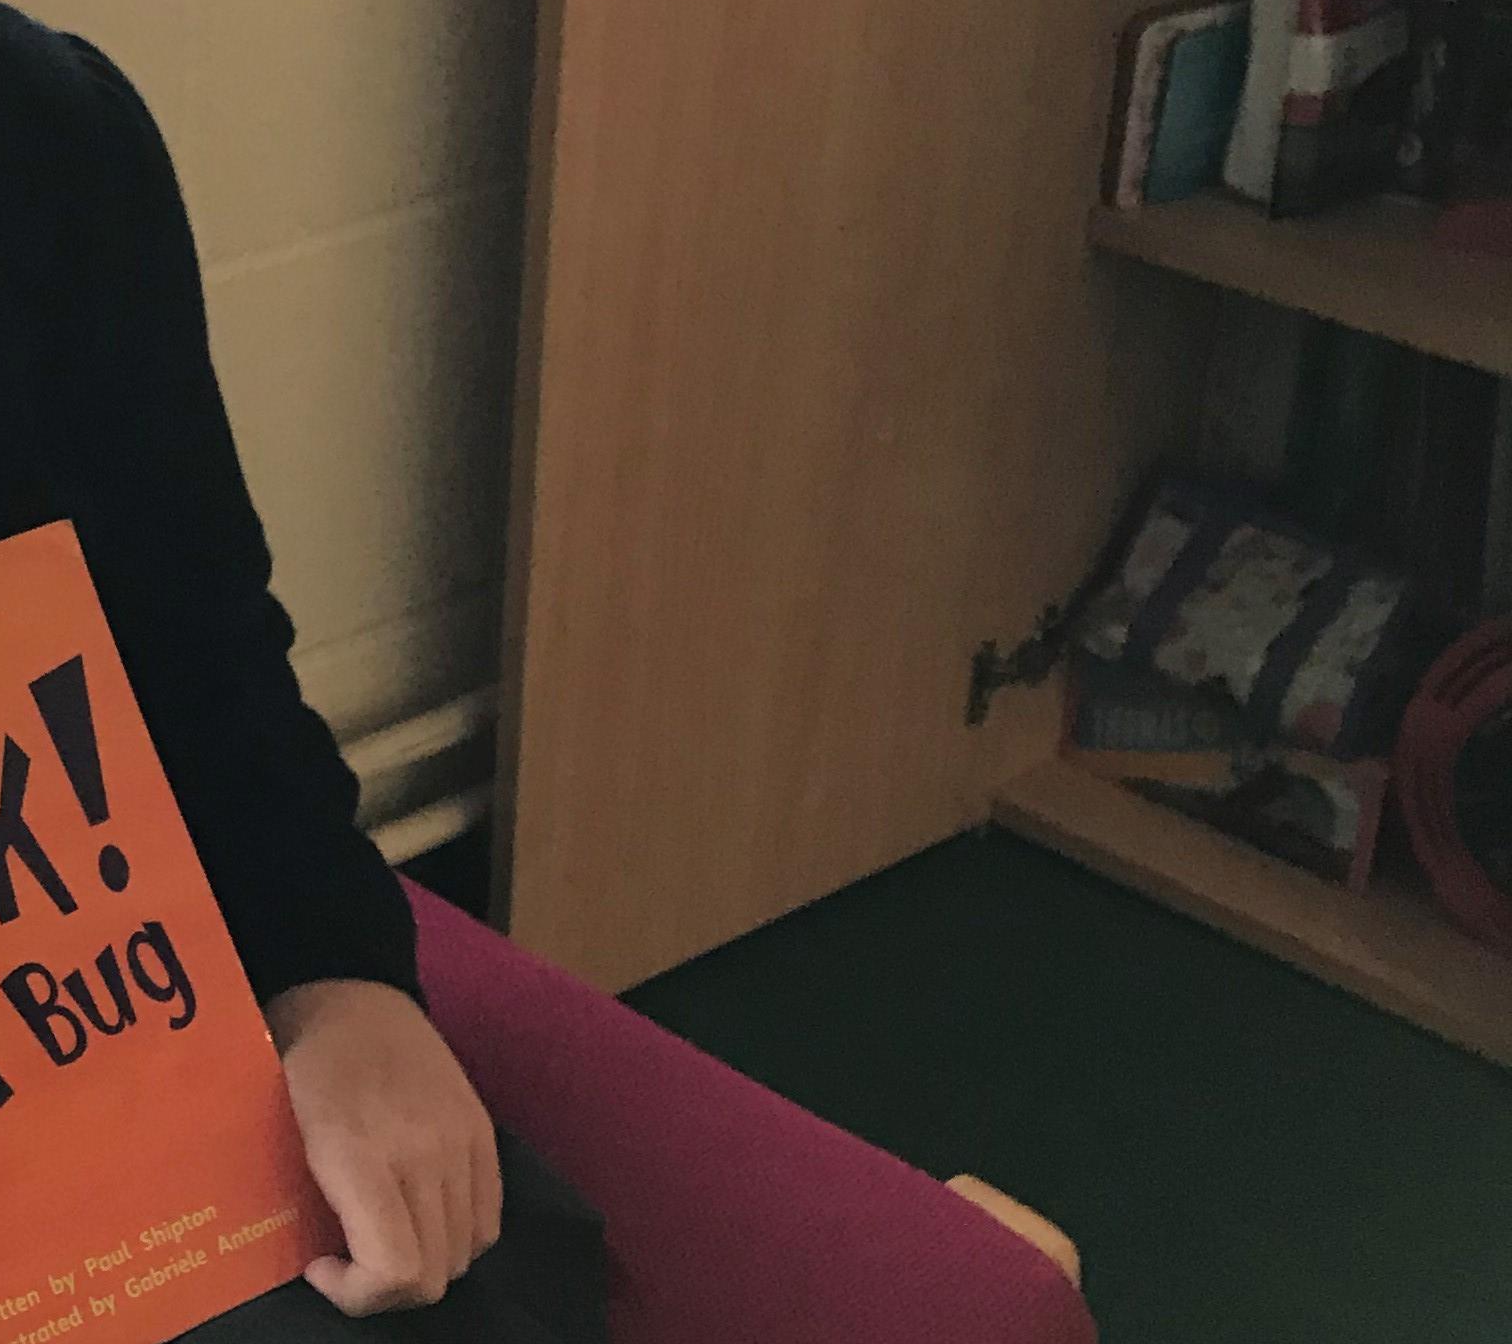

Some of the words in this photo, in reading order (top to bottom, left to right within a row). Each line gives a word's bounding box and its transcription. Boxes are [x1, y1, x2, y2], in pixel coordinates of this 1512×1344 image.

[48, 1270, 77, 1297] by
[84, 1240, 134, 1279] Paul
[139, 1205, 218, 1252] Shipton
[88, 1293, 118, 1318] by
[124, 1247, 209, 1301] Gabriele
